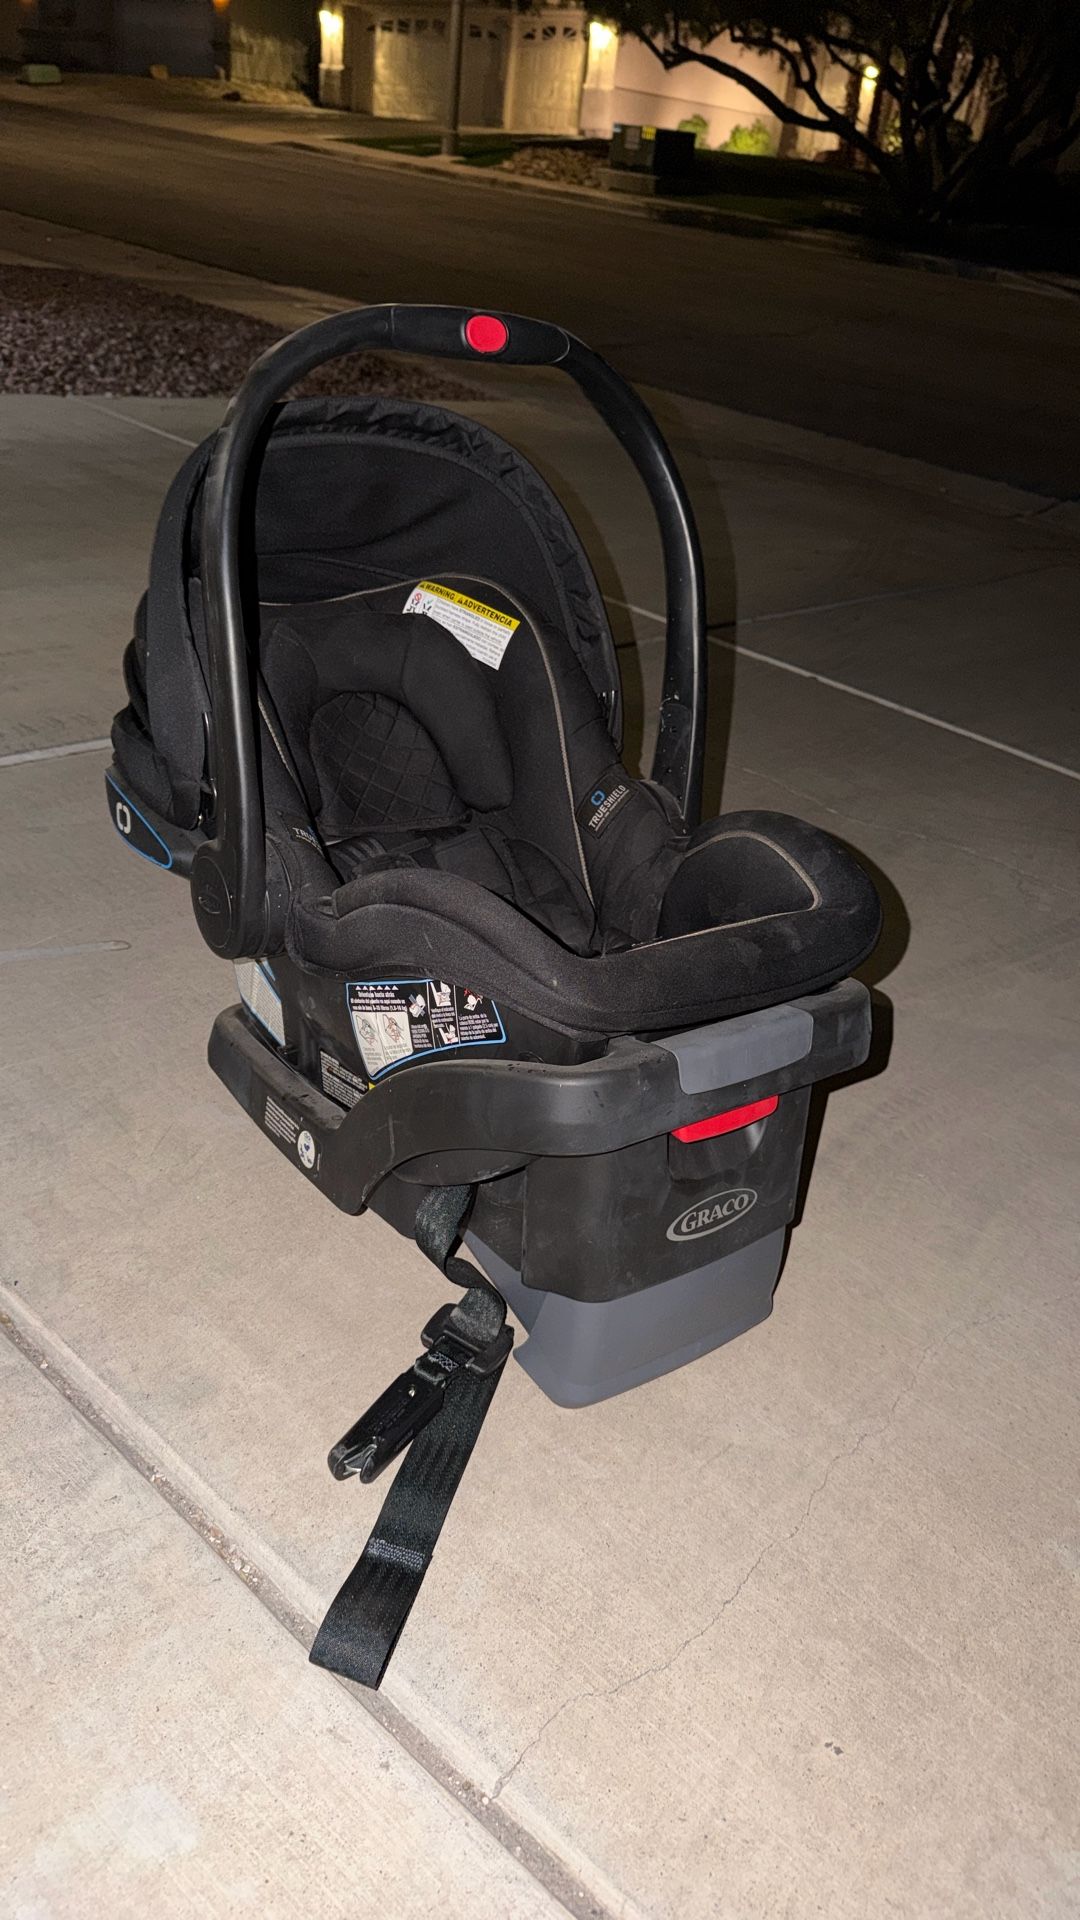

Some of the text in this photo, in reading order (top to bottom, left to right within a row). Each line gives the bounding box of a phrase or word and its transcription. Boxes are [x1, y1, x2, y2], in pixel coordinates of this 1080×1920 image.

[426, 584, 456, 600] WARNING
[464, 599, 513, 627] ADVERTENCIA
[588, 785, 626, 828] TRUESHIELD
[681, 1194, 749, 1232] GRACO
